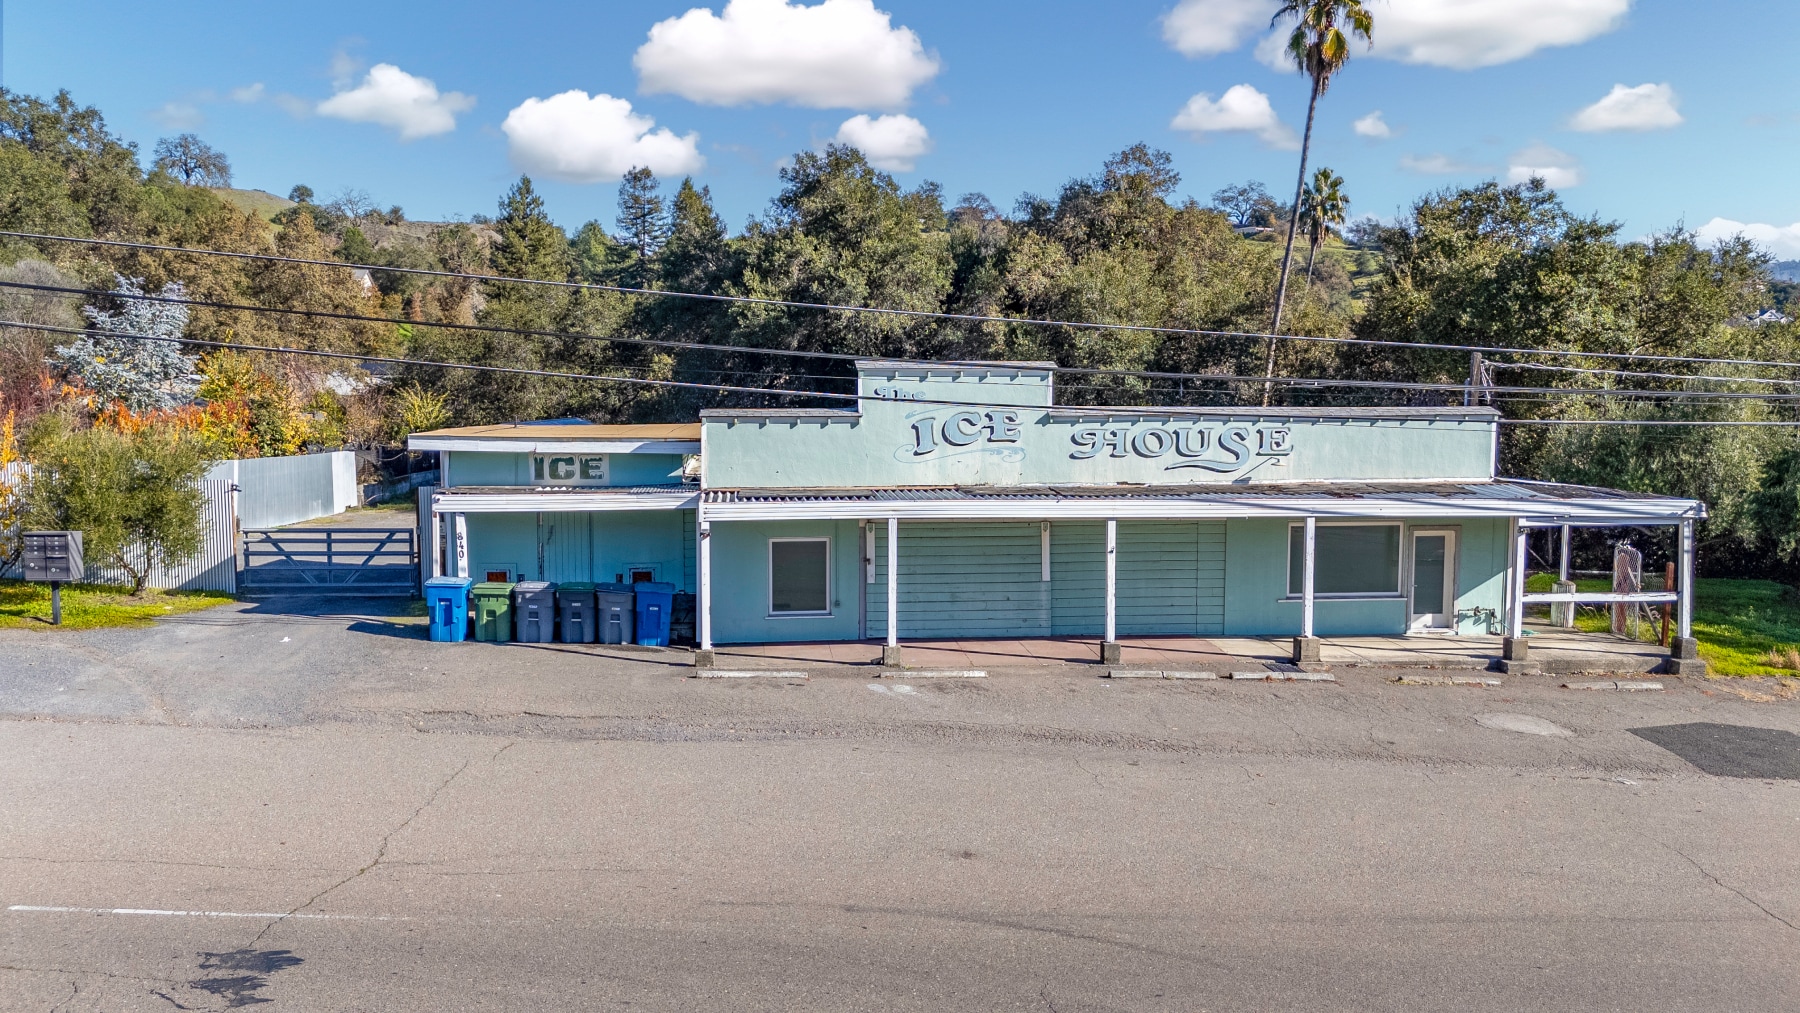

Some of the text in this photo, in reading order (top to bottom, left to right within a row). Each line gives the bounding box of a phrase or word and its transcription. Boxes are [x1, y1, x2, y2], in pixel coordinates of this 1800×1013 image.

[874, 385, 926, 401] The
[911, 411, 1293, 473] ICE HOUSE
[533, 453, 605, 480] ICE
[457, 532, 465, 559] 840
